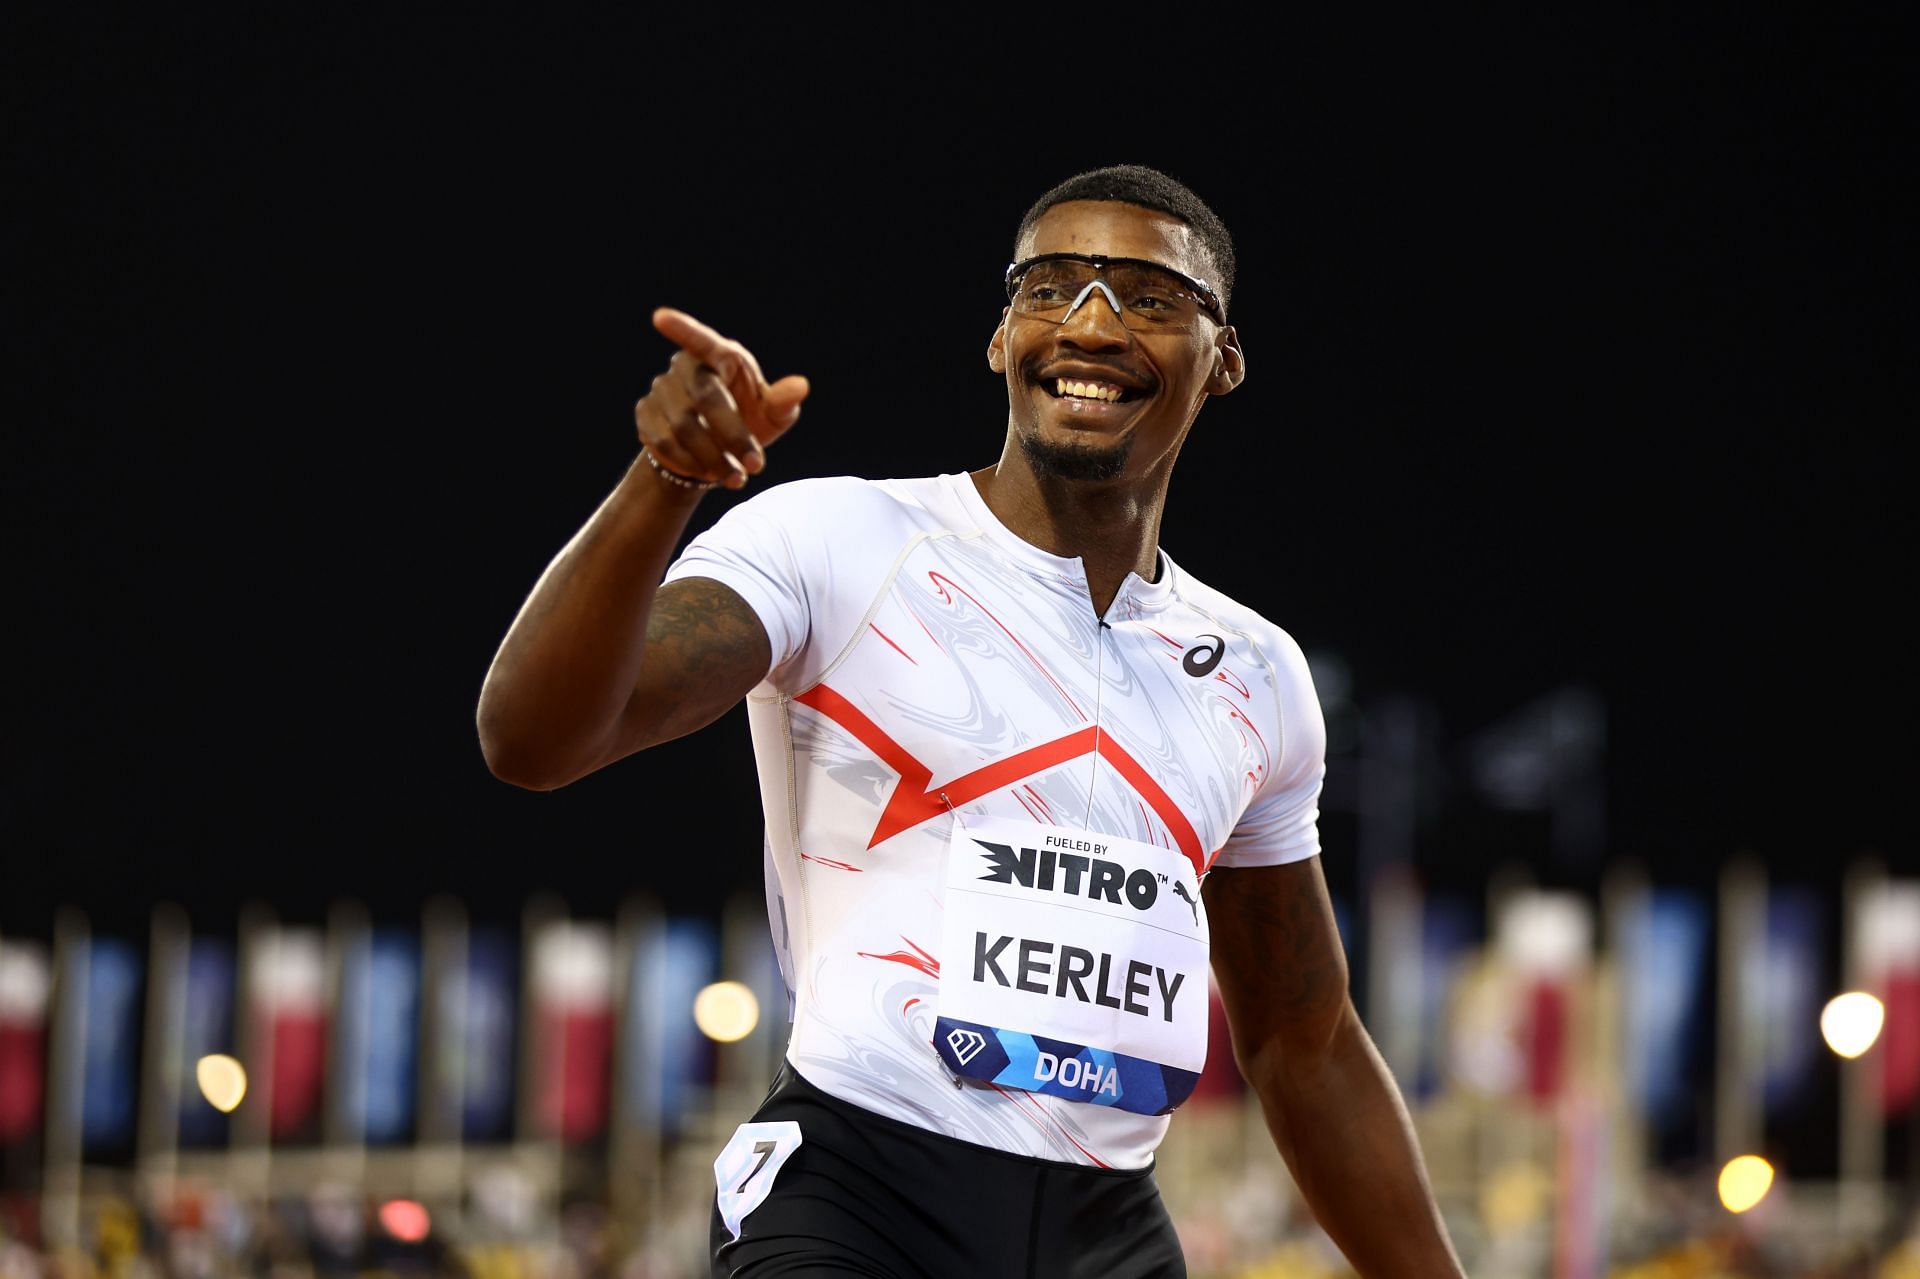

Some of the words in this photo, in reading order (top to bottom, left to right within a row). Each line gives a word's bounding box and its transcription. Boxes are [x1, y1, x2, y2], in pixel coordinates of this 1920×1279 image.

[1046, 836, 1091, 852] FUELED
[1094, 844, 1108, 855] BY
[973, 931, 1185, 1023] KERLEY
[1033, 1051, 1119, 1097] DOHA
[736, 1141, 777, 1194] 7
